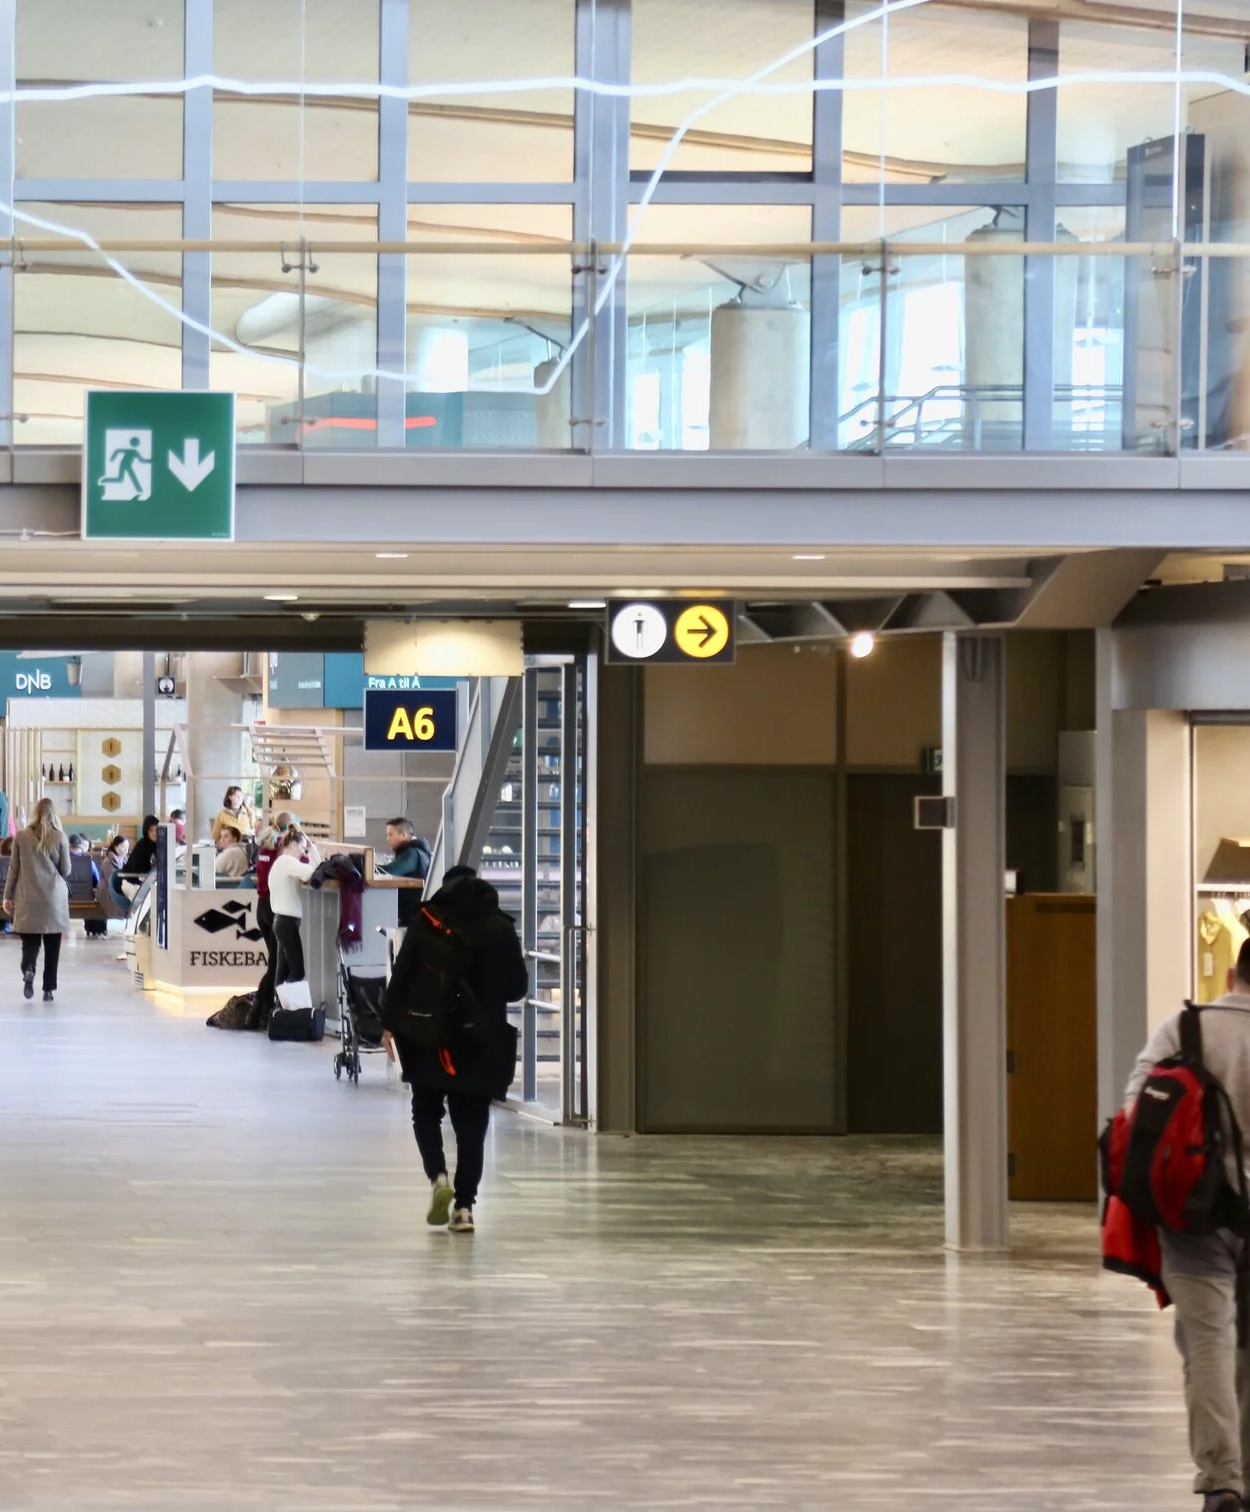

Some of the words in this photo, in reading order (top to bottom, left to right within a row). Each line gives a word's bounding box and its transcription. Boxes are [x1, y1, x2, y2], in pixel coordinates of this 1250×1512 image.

[15, 669, 52, 694] DNB
[368, 676, 386, 689] Fra
[399, 676, 410, 689] til
[387, 707, 435, 741] A6
[190, 950, 269, 967] FISKEBA
